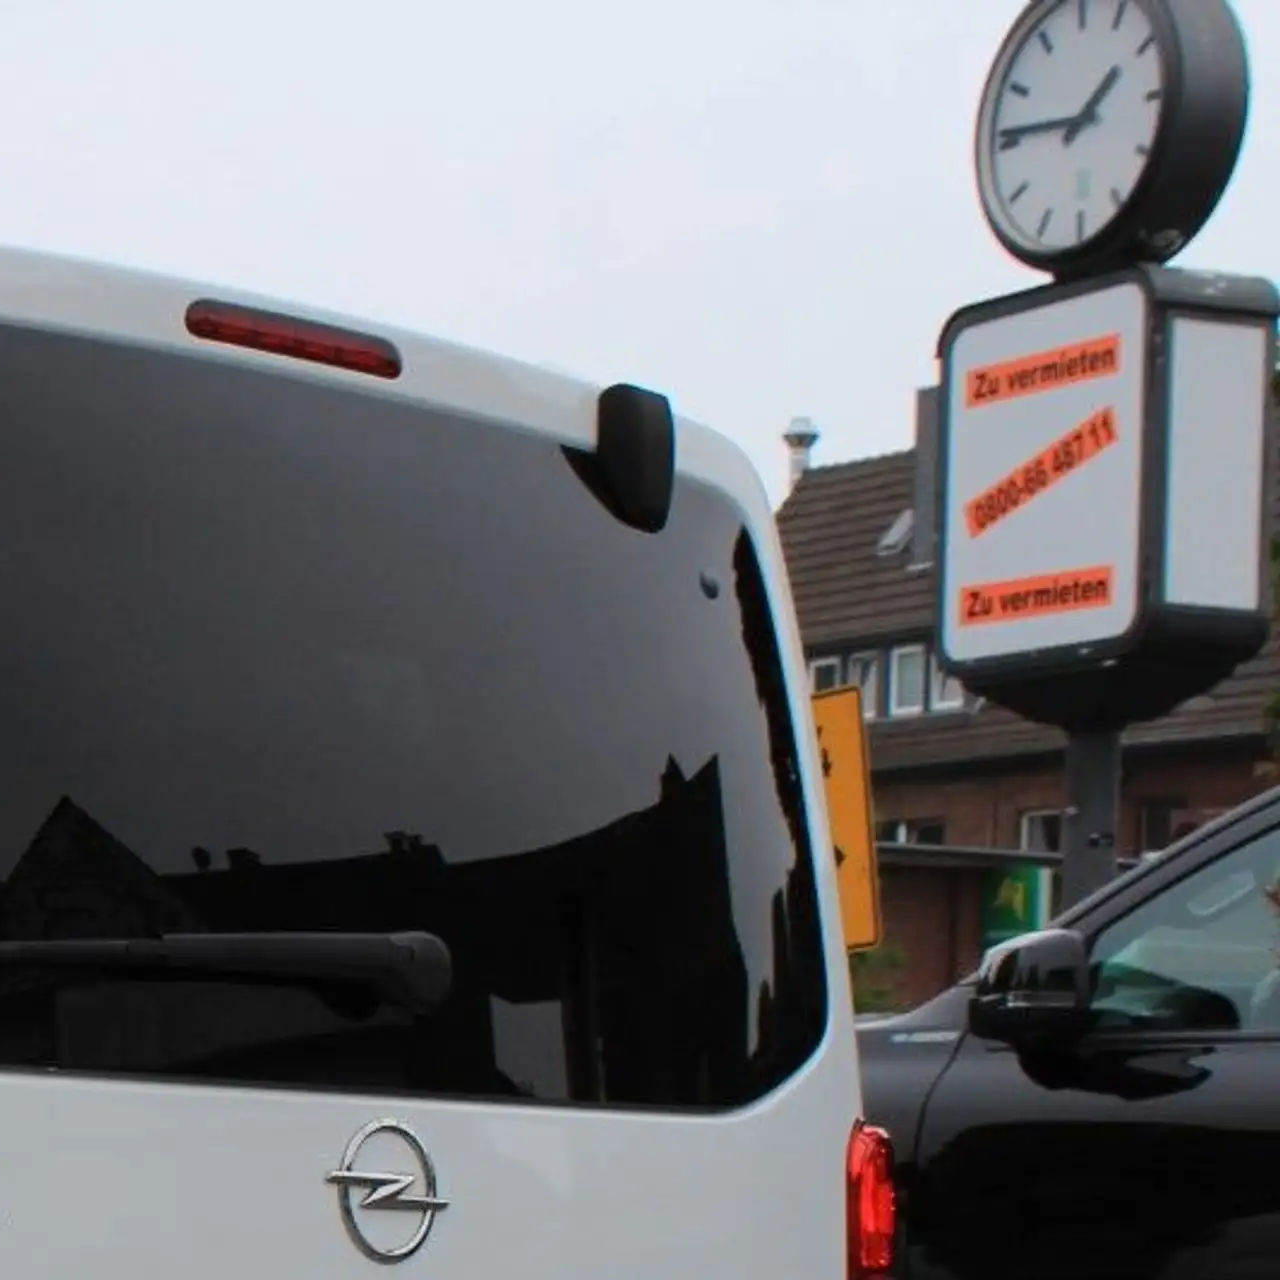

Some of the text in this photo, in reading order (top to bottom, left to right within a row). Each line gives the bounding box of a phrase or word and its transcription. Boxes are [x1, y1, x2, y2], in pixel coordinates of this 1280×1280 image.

[973, 348, 1116, 400] Zu vermieten
[966, 577, 1108, 618] Zu vermieten
